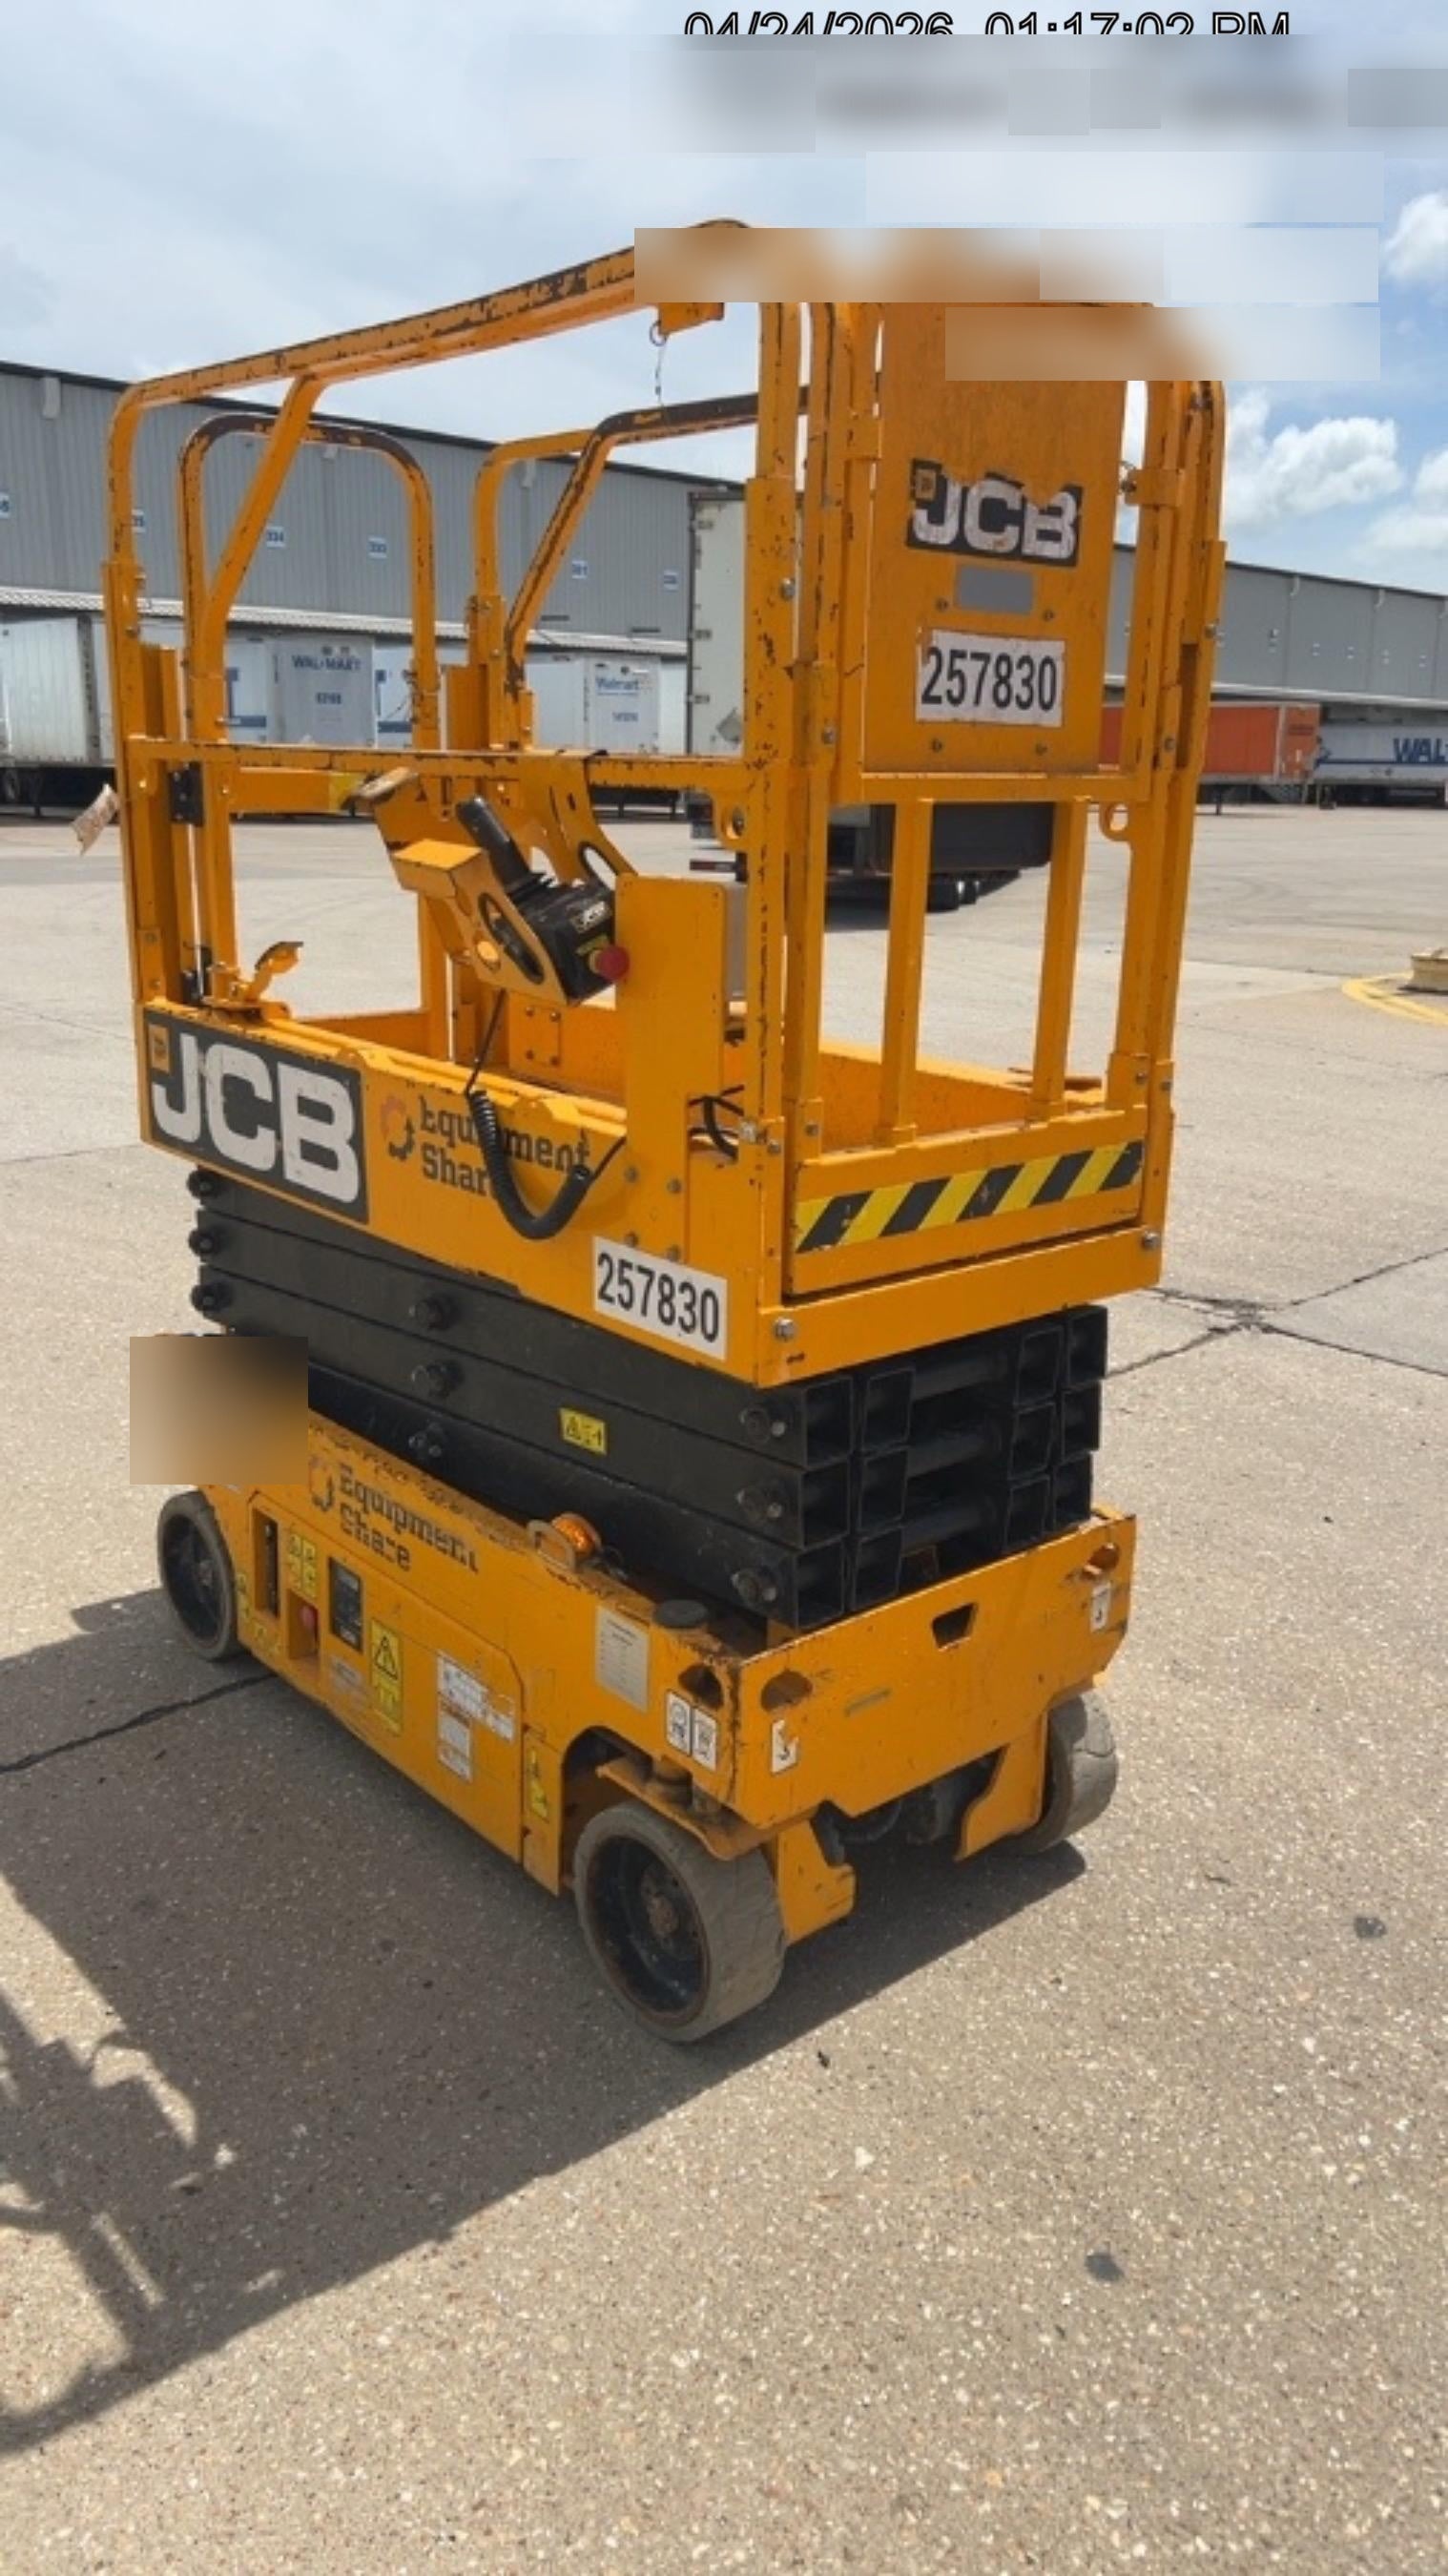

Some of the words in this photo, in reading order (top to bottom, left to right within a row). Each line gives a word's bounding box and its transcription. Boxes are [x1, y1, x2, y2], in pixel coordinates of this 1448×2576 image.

[913, 476, 1077, 560] JCB
[921, 647, 1057, 712] 257830
[152, 1032, 360, 1204] JCB
[422, 1142, 490, 1197] Shar
[598, 1252, 719, 1343] 257830
